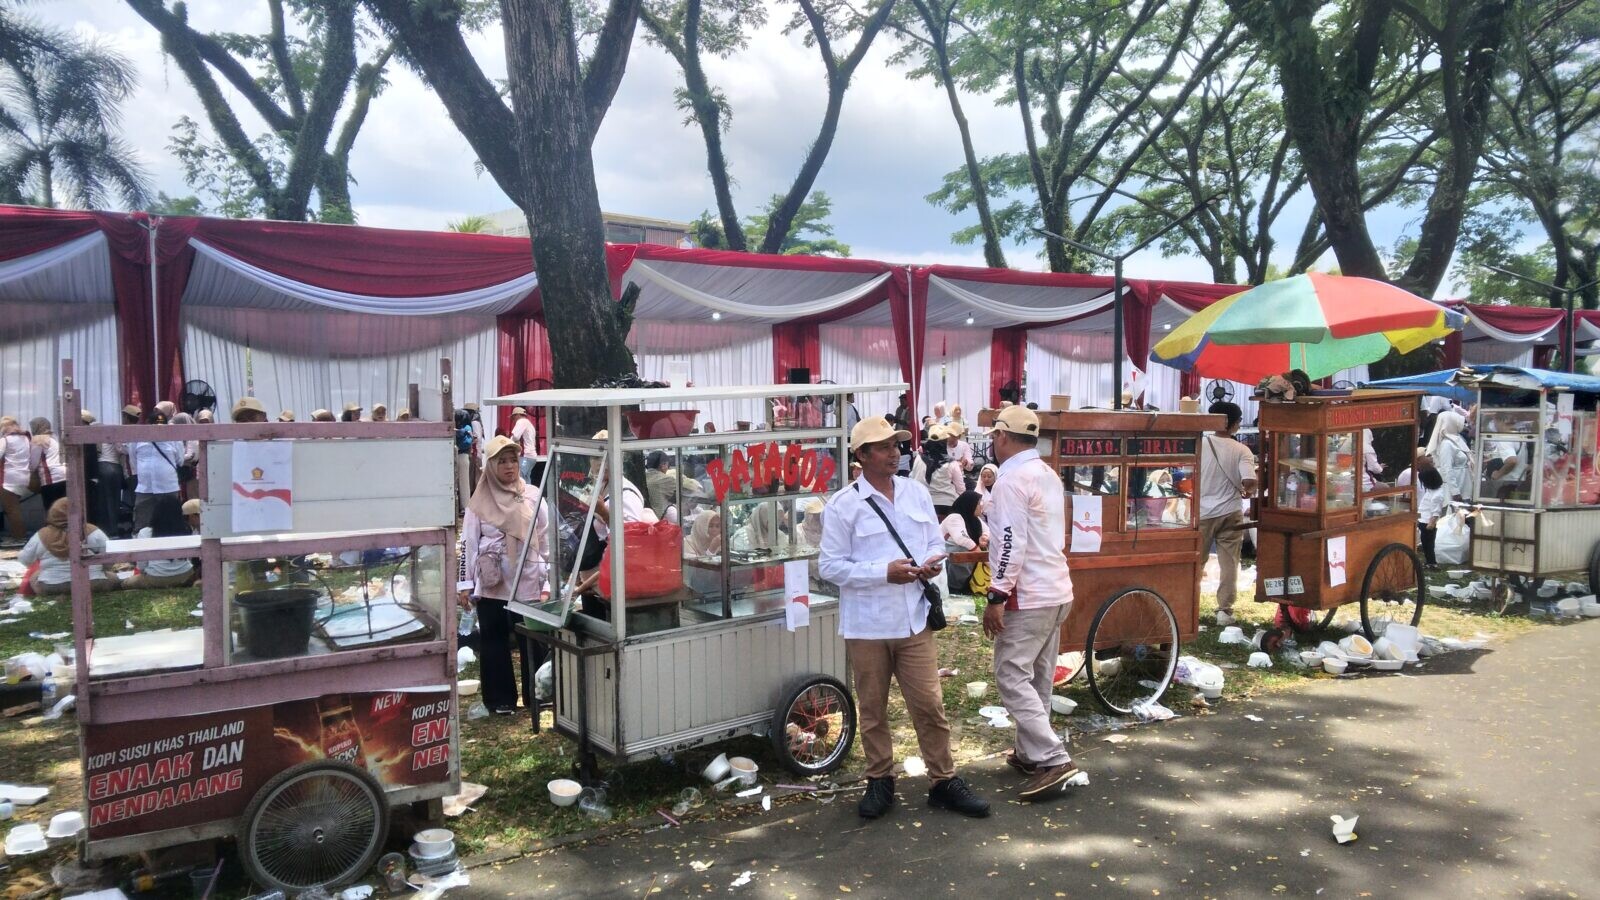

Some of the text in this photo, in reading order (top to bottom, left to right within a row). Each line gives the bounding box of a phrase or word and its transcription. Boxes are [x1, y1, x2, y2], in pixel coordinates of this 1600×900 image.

[706, 440, 836, 506] BATAGOR
[996, 526, 1012, 580] GERINDRA
[374, 692, 403, 711] NEW
[412, 704, 435, 720] KOPI
[87, 720, 245, 770] KOPI SUSU KHAS THAILAND
[89, 739, 244, 800] ENAAK DAN
[90, 769, 243, 827] NENDAAANG
